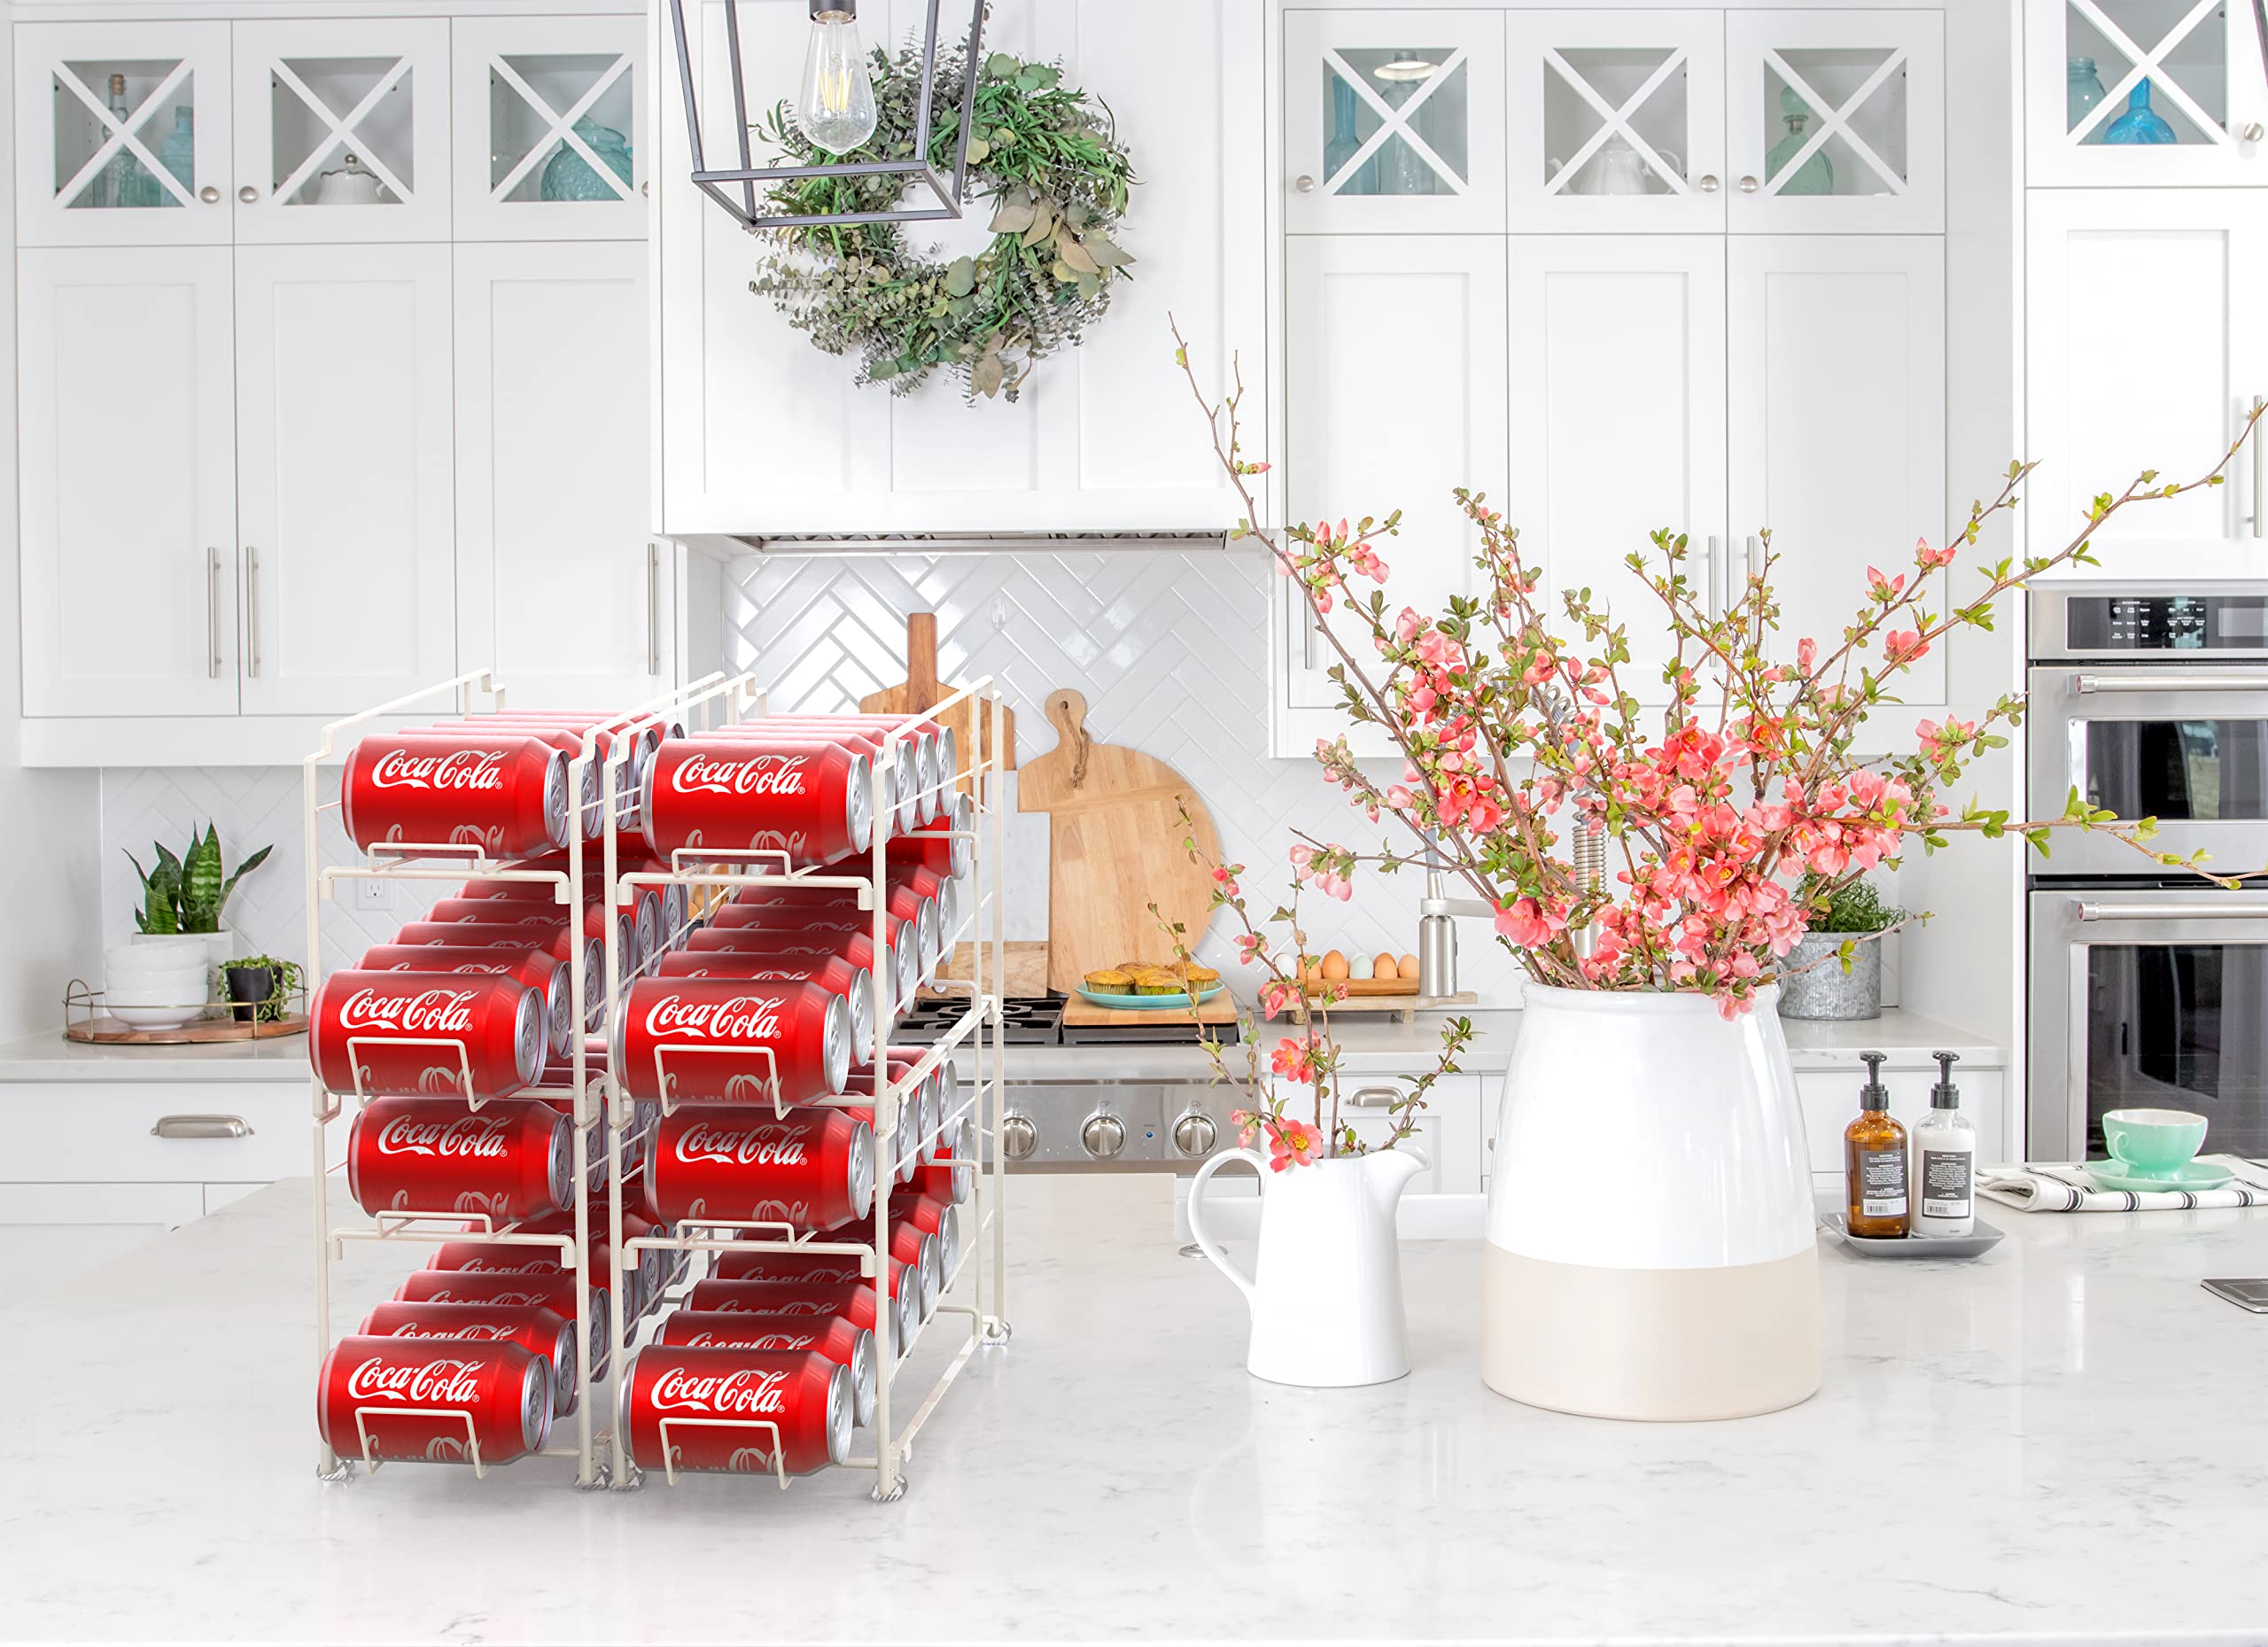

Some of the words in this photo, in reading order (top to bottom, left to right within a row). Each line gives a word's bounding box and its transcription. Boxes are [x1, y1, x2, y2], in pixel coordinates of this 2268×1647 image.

[372, 749, 509, 790] Coca-Cola
[672, 753, 811, 795] Coca-Cola
[339, 988, 478, 1031] Coca-Cola
[646, 995, 787, 1039] Coca-Cola
[378, 1115, 513, 1158] Coca-Cola
[676, 1122, 812, 1166] Coca-Cola
[348, 1357, 486, 1403] Coca-Cola
[651, 1367, 789, 1414] Coca-Cola
